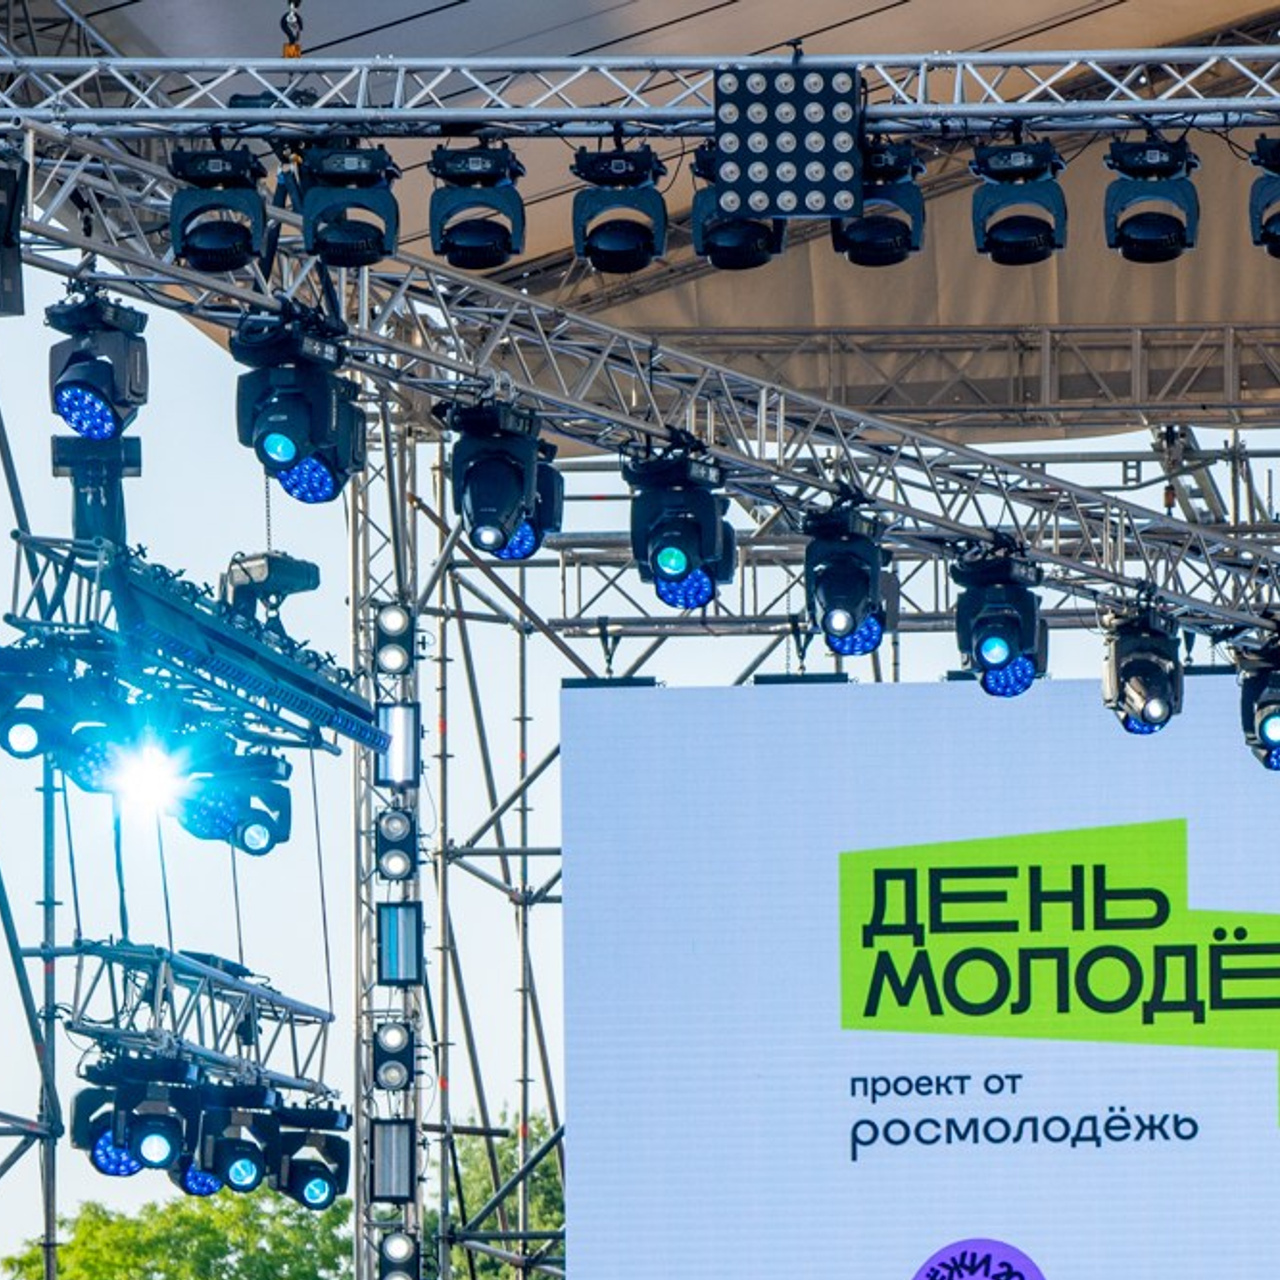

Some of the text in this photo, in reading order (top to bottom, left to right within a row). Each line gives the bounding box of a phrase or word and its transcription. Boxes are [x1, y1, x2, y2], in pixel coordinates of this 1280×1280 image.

[862, 864, 1171, 948] ДЕНЬ
[850, 1073, 1023, 1104] проект от
[850, 1106, 1200, 1162] росмолодёжь
